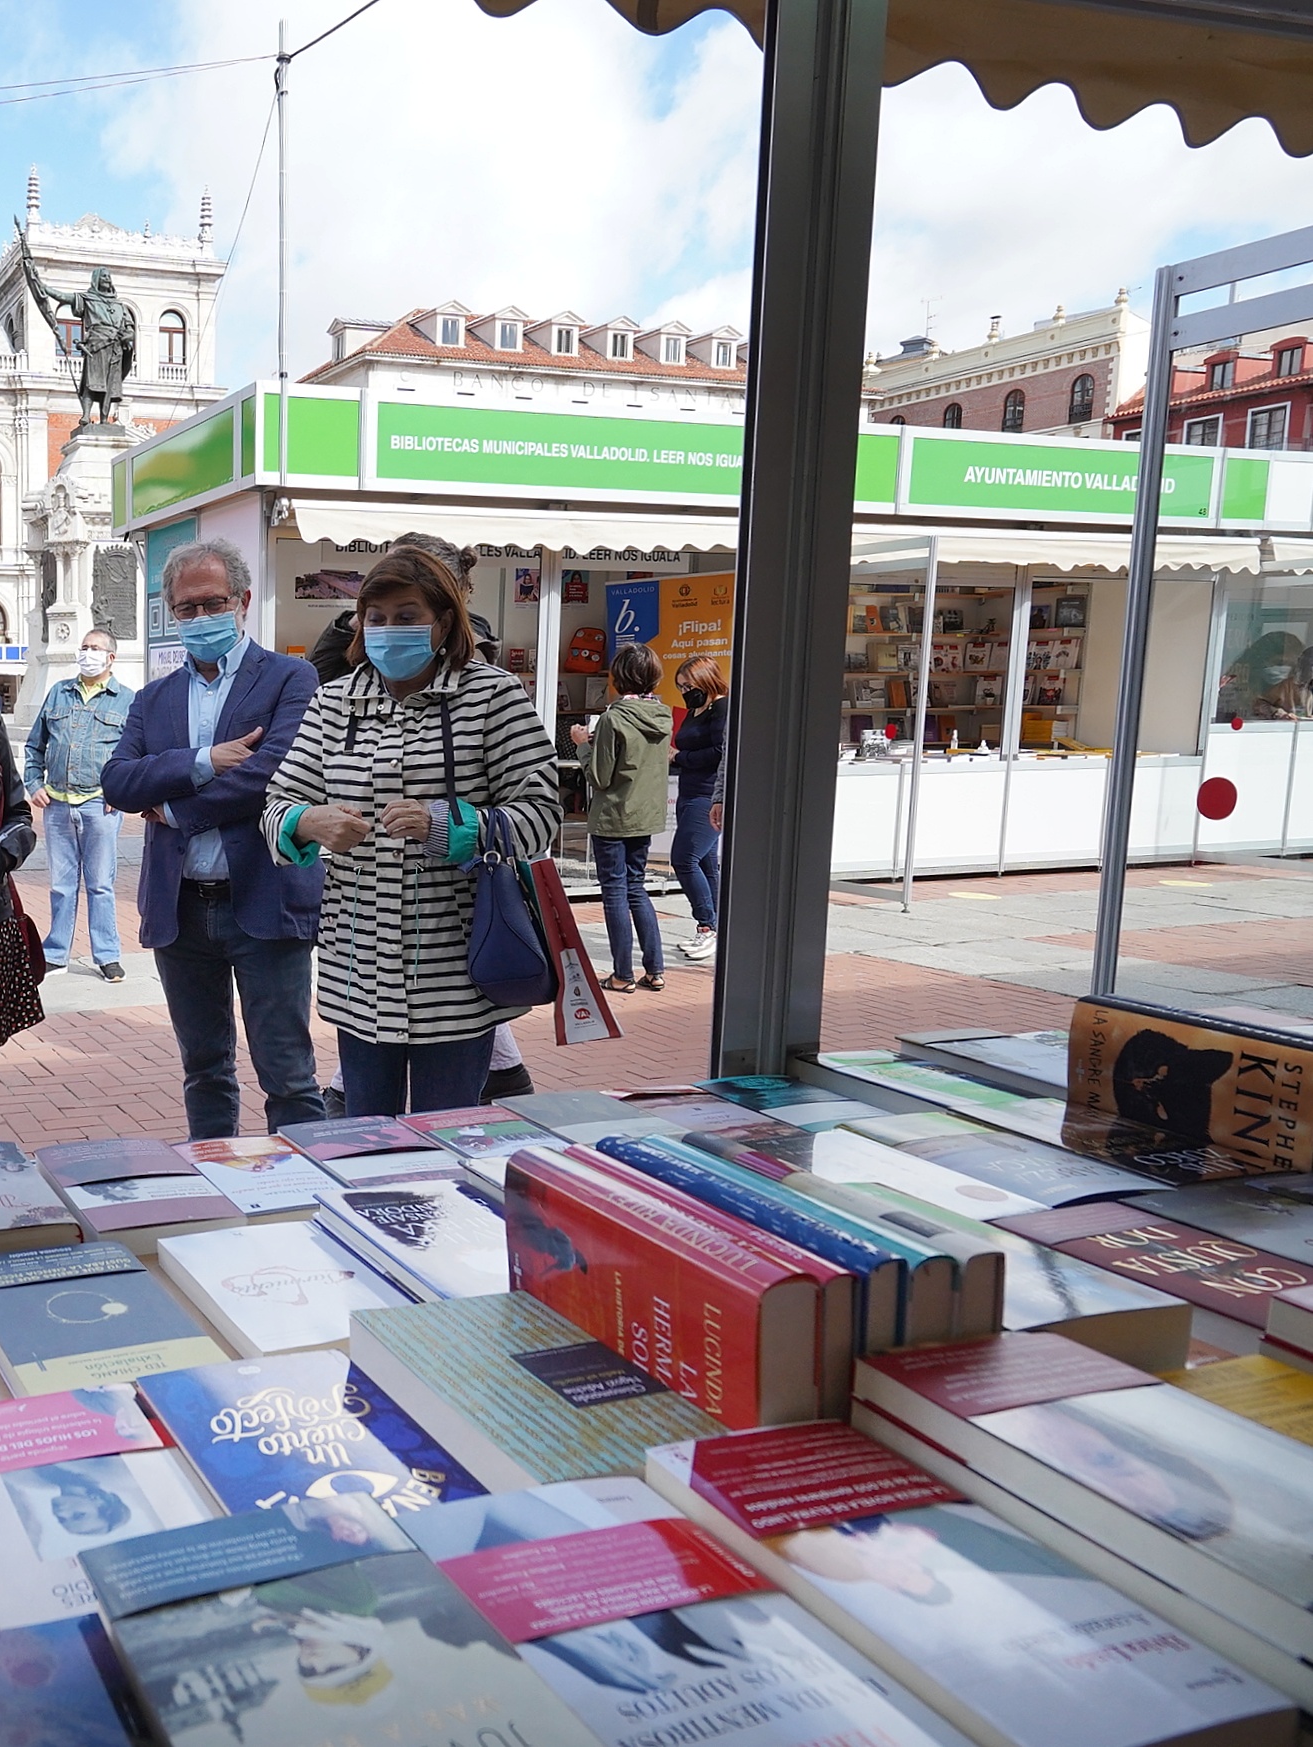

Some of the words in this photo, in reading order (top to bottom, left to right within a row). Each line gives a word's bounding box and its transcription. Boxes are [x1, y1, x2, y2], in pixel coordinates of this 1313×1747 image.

[452, 369, 545, 394] BANCO
[582, 381, 613, 398] DE
[390, 433, 480, 455] BIBLIOTECAS
[482, 438, 569, 458] MUNICIPALES
[570, 443, 651, 463] VALLADOLID.
[653, 448, 686, 466] LEER
[687, 451, 714, 467] NOS
[963, 465, 1083, 490] AYUNTAMIENTO
[1084, 471, 1176, 495] VALLADID
[582, 545, 612, 562] LEER
[613, 548, 638, 563] NOS
[640, 549, 682, 564] IGUALA
[610, 586, 656, 596] VALLADOLID
[678, 619, 723, 636] ¡Flipa!
[671, 638, 695, 650] Aquí
[696, 637, 729, 648] pasan
[662, 651, 687, 660] cosas
[1091, 1009, 1109, 1027] LA
[1087, 1029, 1106, 1086] SANGRE
[1232, 1050, 1280, 1172] KIN
[604, 1192, 659, 1224] RILEY
[659, 1218, 759, 1273] LUCINDA
[1084, 1225, 1181, 1250] DOR
[8, 1249, 38, 1259] EDICIÓN
[38, 1246, 72, 1256] SEGUNDA
[1109, 1239, 1259, 1277] QUISTA
[21, 1265, 67, 1277] CIENCIA
[83, 1257, 131, 1268] GUSTABA
[17, 1274, 42, 1283] QUE
[614, 1270, 622, 1285] LA
[1198, 1266, 1308, 1298] CON
[614, 1286, 624, 1338] HISTORIA
[616, 1338, 626, 1355] DE
[84, 1352, 163, 1372] Exhalación
[702, 1301, 723, 1416] LUCINDA
[90, 1365, 142, 1380] CHIANG
[143, 1361, 168, 1375] TED
[677, 1360, 699, 1401] LA
[570, 1382, 647, 1404] Chimamanda
[210, 1383, 371, 1445] Perfecto
[35, 1431, 74, 1447] HIJOS
[73, 1427, 98, 1439] LOS
[257, 1418, 366, 1457] Cuento
[1, 1448, 29, 1461] parte
[8, 1438, 34, 1453] DEL
[31, 1443, 69, 1457] segunda
[304, 1440, 352, 1468] Un
[847, 1492, 895, 1510] NOVELA
[895, 1486, 933, 1502] NUEVA
[743, 1495, 796, 1513] vendidos
[790, 1504, 834, 1522] ELVIRA
[833, 1502, 848, 1514] DE
[750, 1511, 789, 1530] LINDO
[738, 1661, 790, 1691] LOS
[614, 1671, 740, 1725] ADULTOS
[615, 1702, 783, 1747] MENTIROSA
